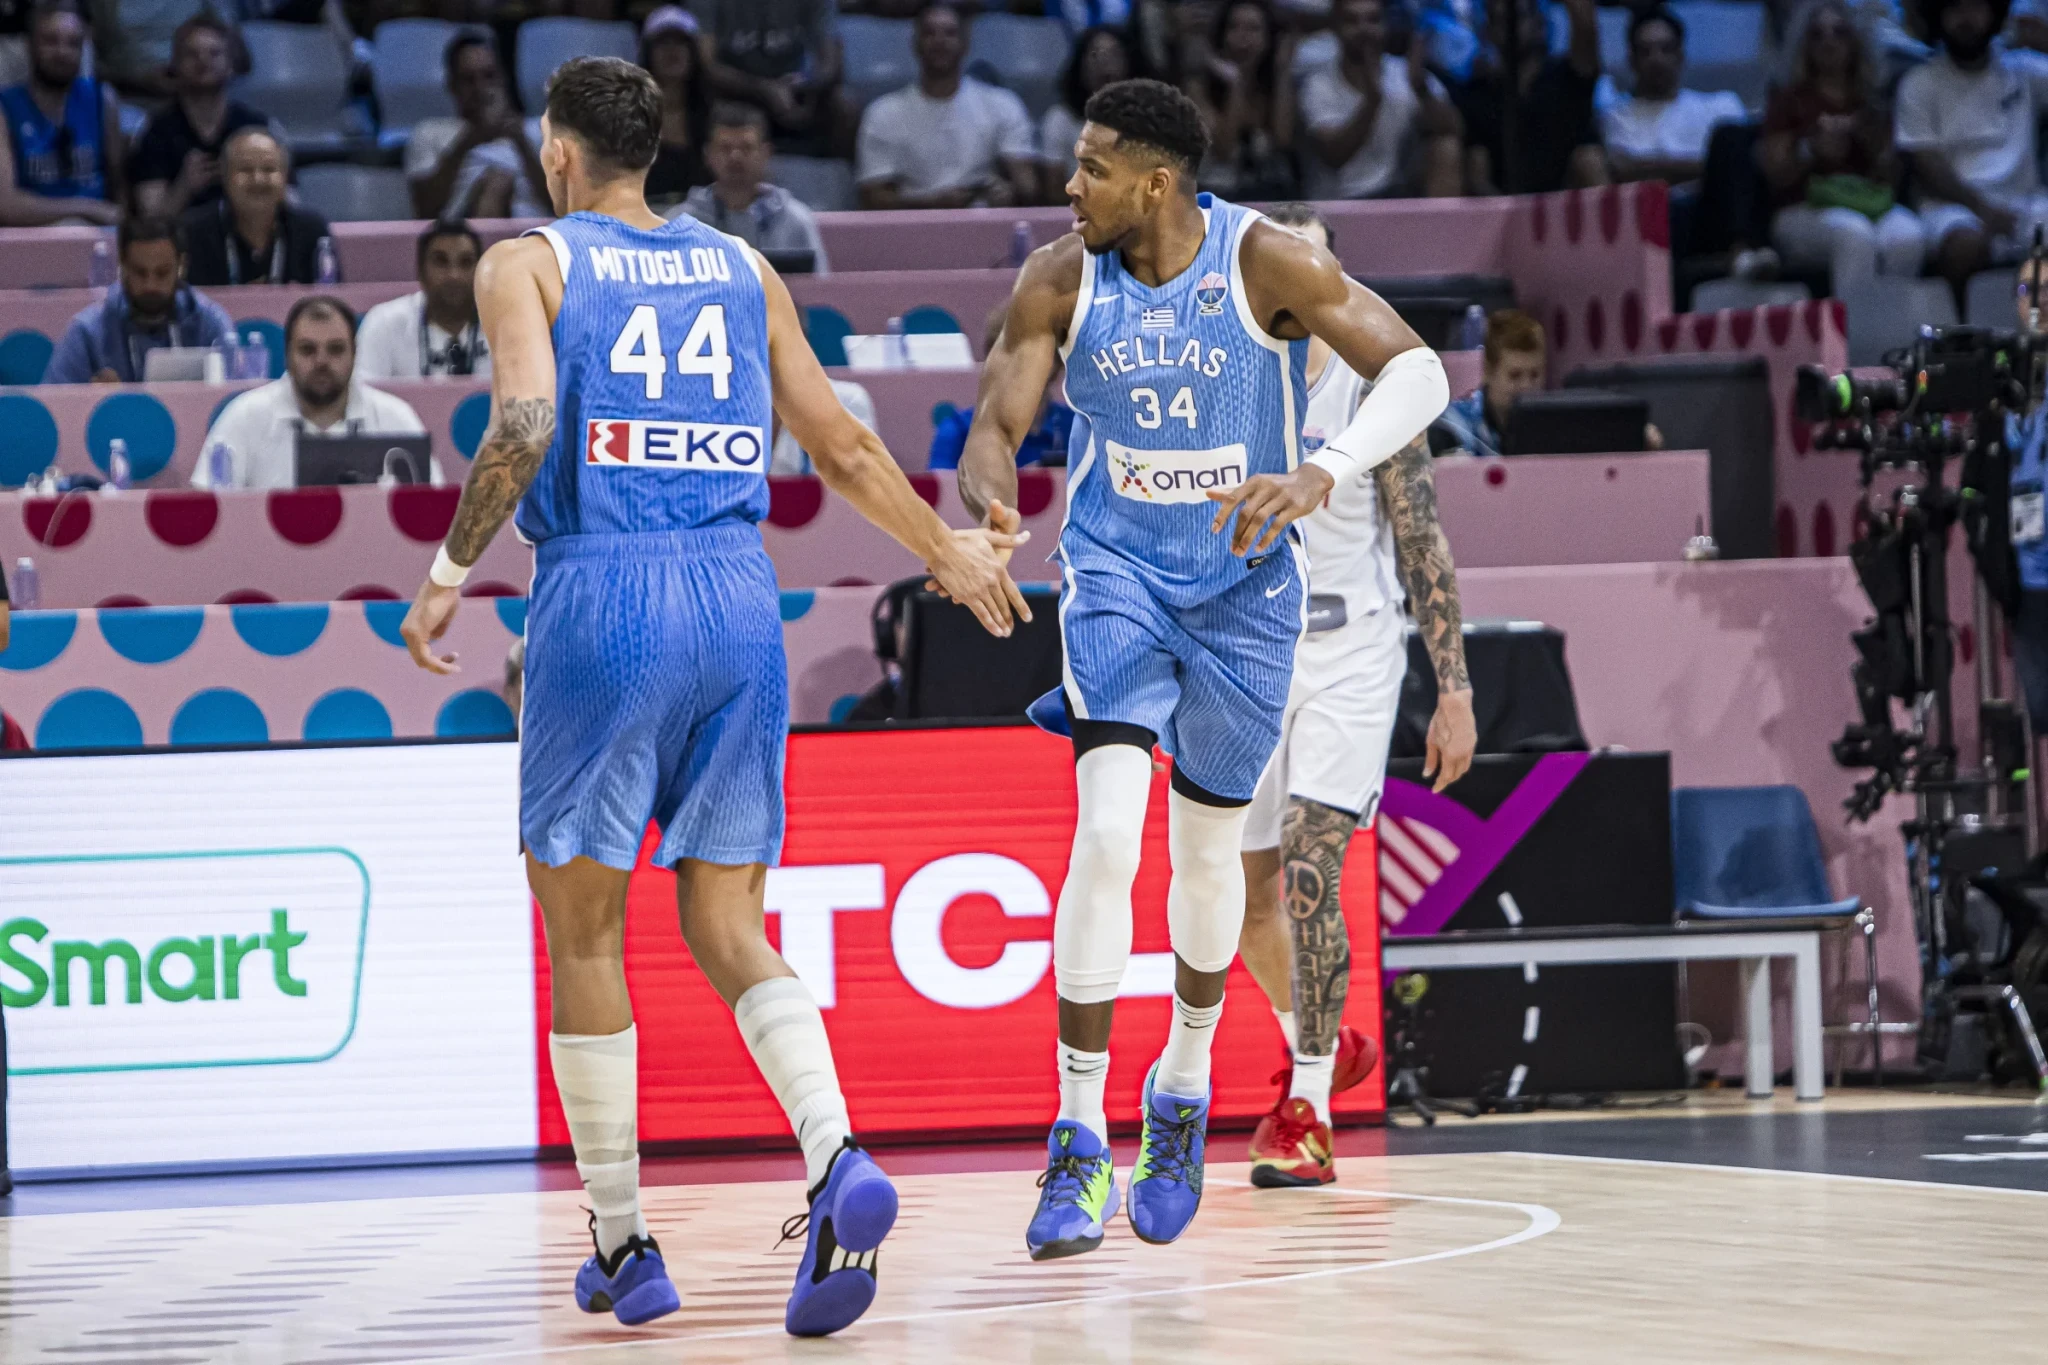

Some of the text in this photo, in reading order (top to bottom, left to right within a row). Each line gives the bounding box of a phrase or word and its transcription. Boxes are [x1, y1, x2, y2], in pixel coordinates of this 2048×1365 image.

[588, 246, 731, 285] MITOGLOU
[609, 303, 733, 400] 44
[1091, 334, 1229, 382] HELLAS
[1129, 386, 1199, 430] 34
[643, 427, 761, 466] EKO
[0, 907, 308, 1009] Smart
